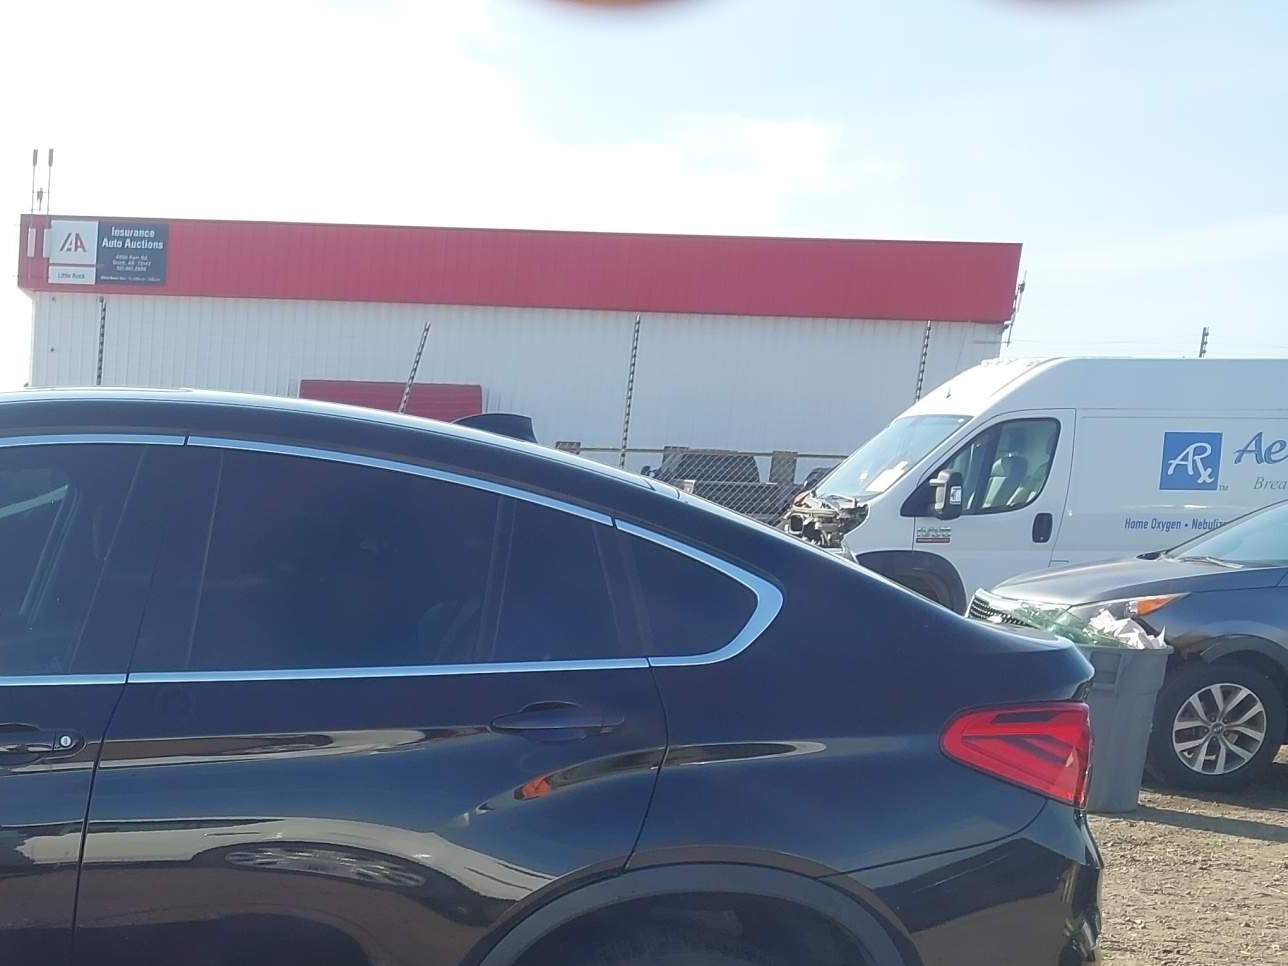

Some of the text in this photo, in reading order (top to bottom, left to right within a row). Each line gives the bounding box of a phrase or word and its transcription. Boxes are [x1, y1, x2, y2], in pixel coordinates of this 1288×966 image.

[111, 226, 155, 238] Insurance
[102, 238, 163, 249] Auto Auctions
[1234, 431, 1288, 465] Ae
[1124, 517, 1148, 529] Home
[1151, 517, 1181, 532] Oxygen
